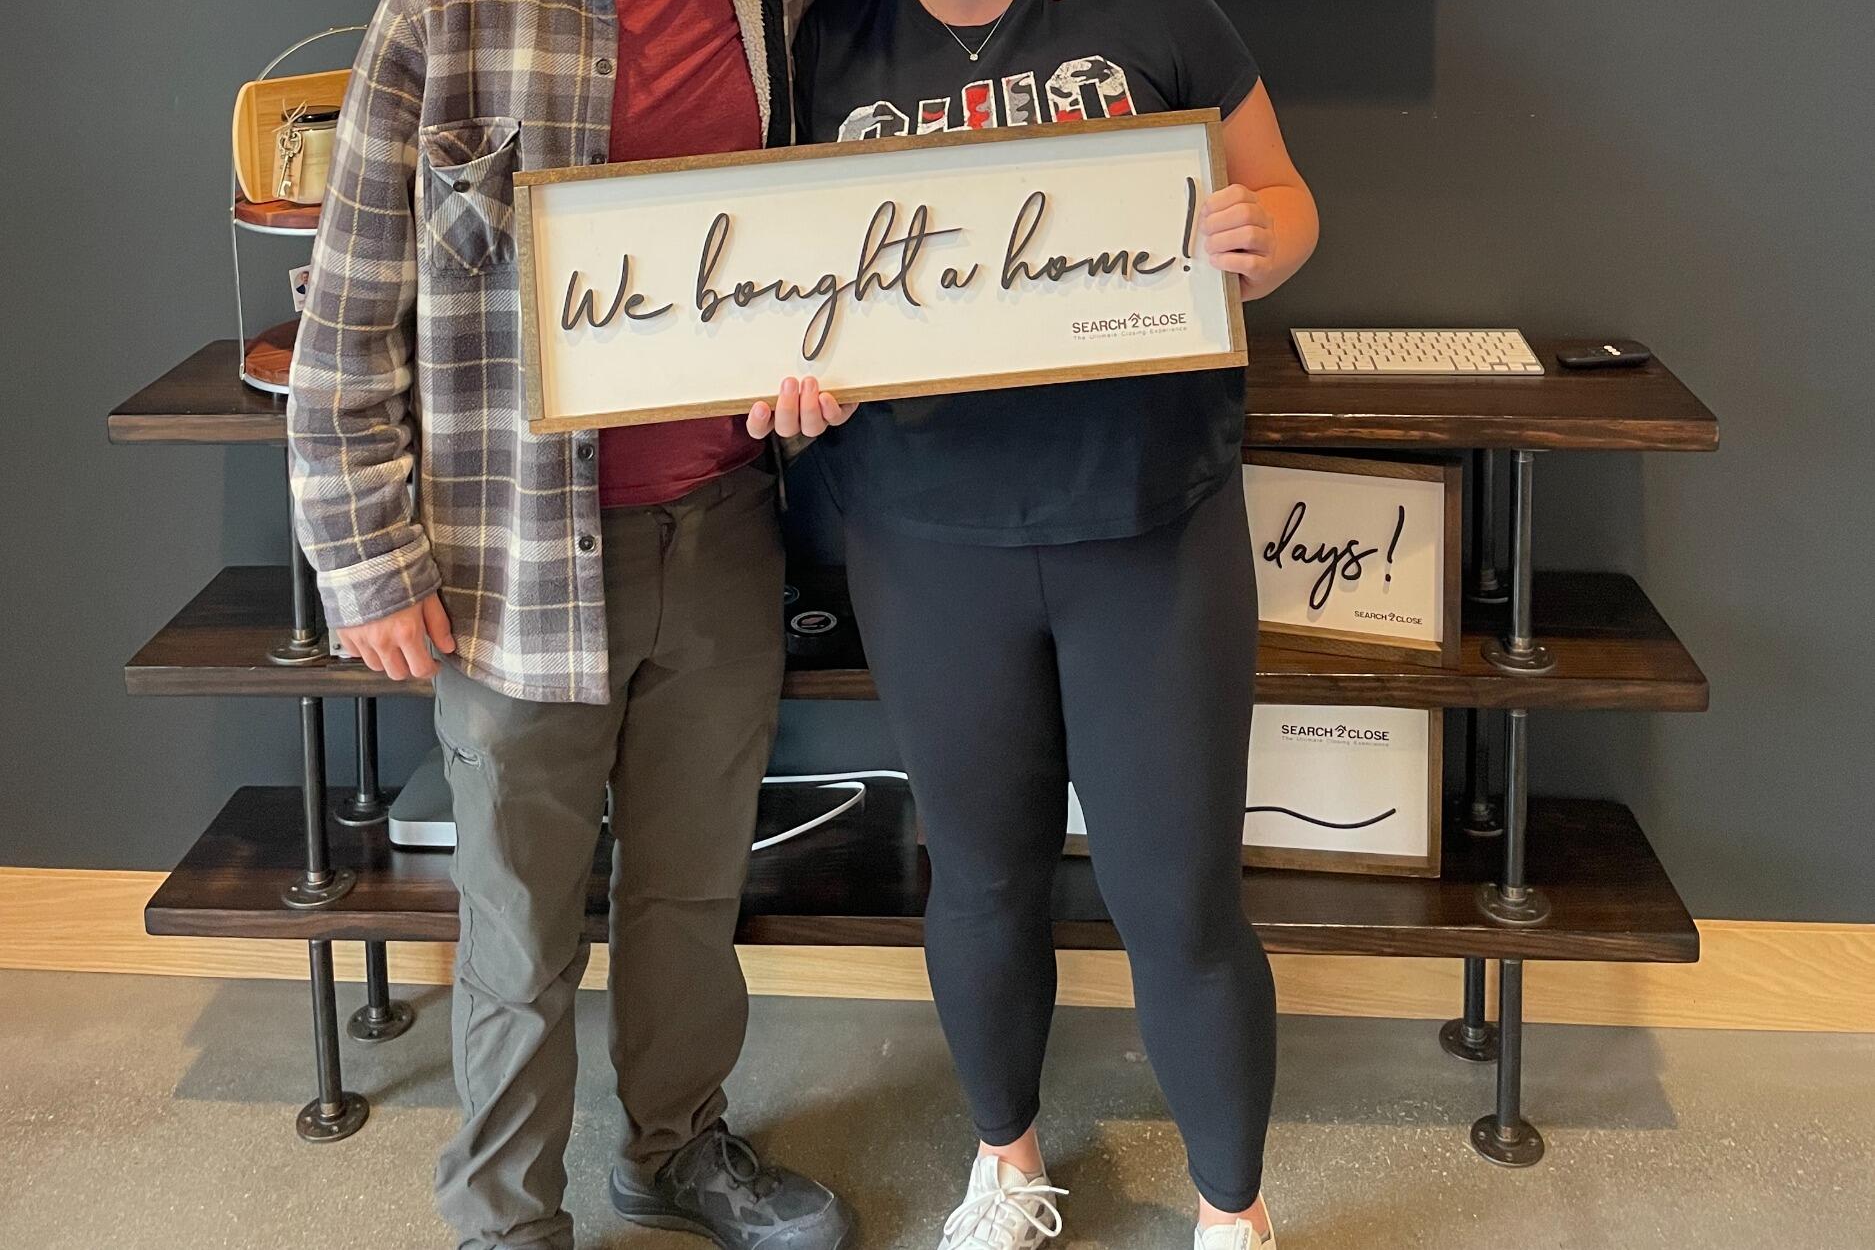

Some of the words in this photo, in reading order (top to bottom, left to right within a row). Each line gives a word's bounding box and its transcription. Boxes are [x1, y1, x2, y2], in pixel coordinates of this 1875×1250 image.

[562, 254, 674, 331] We
[696, 200, 962, 361] bought
[940, 263, 978, 291] a
[1001, 176, 1196, 290] home!
[1072, 318, 1127, 333] SEARCH
[1142, 313, 1187, 327] CLOSE
[1354, 610, 1387, 621] SEARCH
[1395, 615, 1423, 625] CLOSE
[1281, 724, 1333, 738] SEARCH
[1347, 729, 1390, 741] CLOSE
